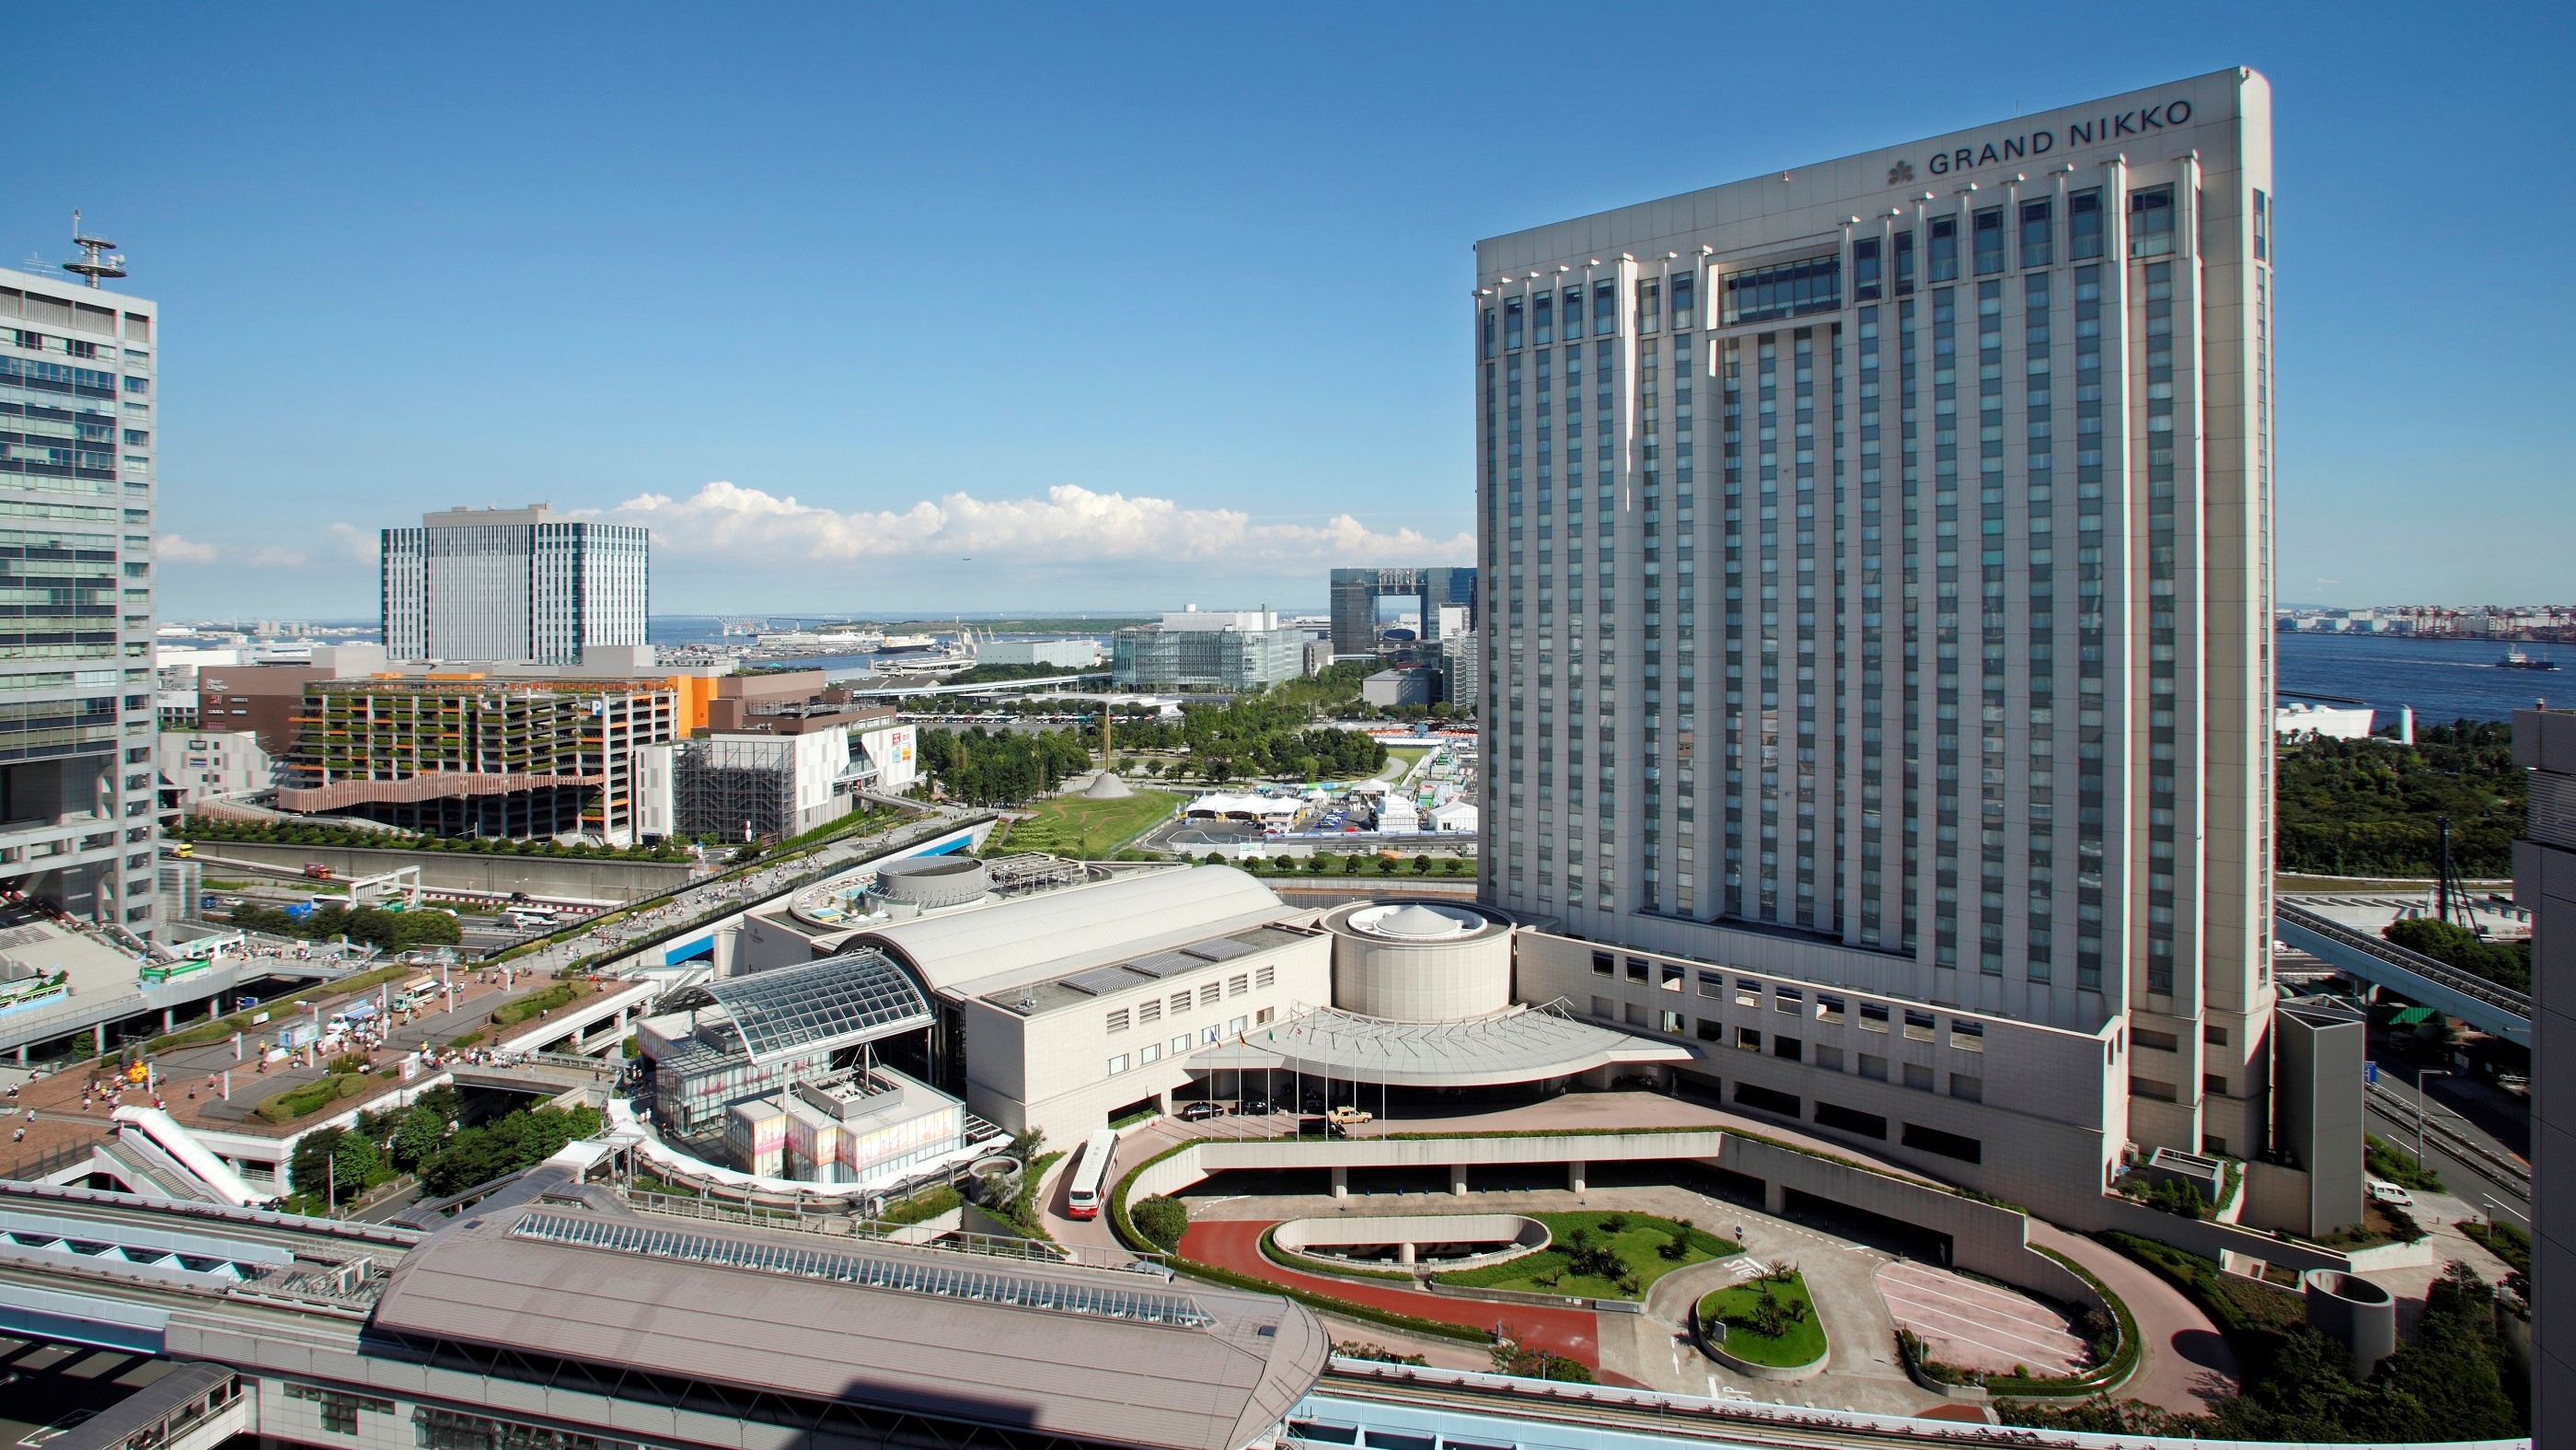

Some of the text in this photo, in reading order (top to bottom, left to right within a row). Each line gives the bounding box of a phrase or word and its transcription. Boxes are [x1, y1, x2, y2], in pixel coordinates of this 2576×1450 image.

[1929, 100, 2192, 175] GRAND NIKKO
[592, 701, 602, 715] P
